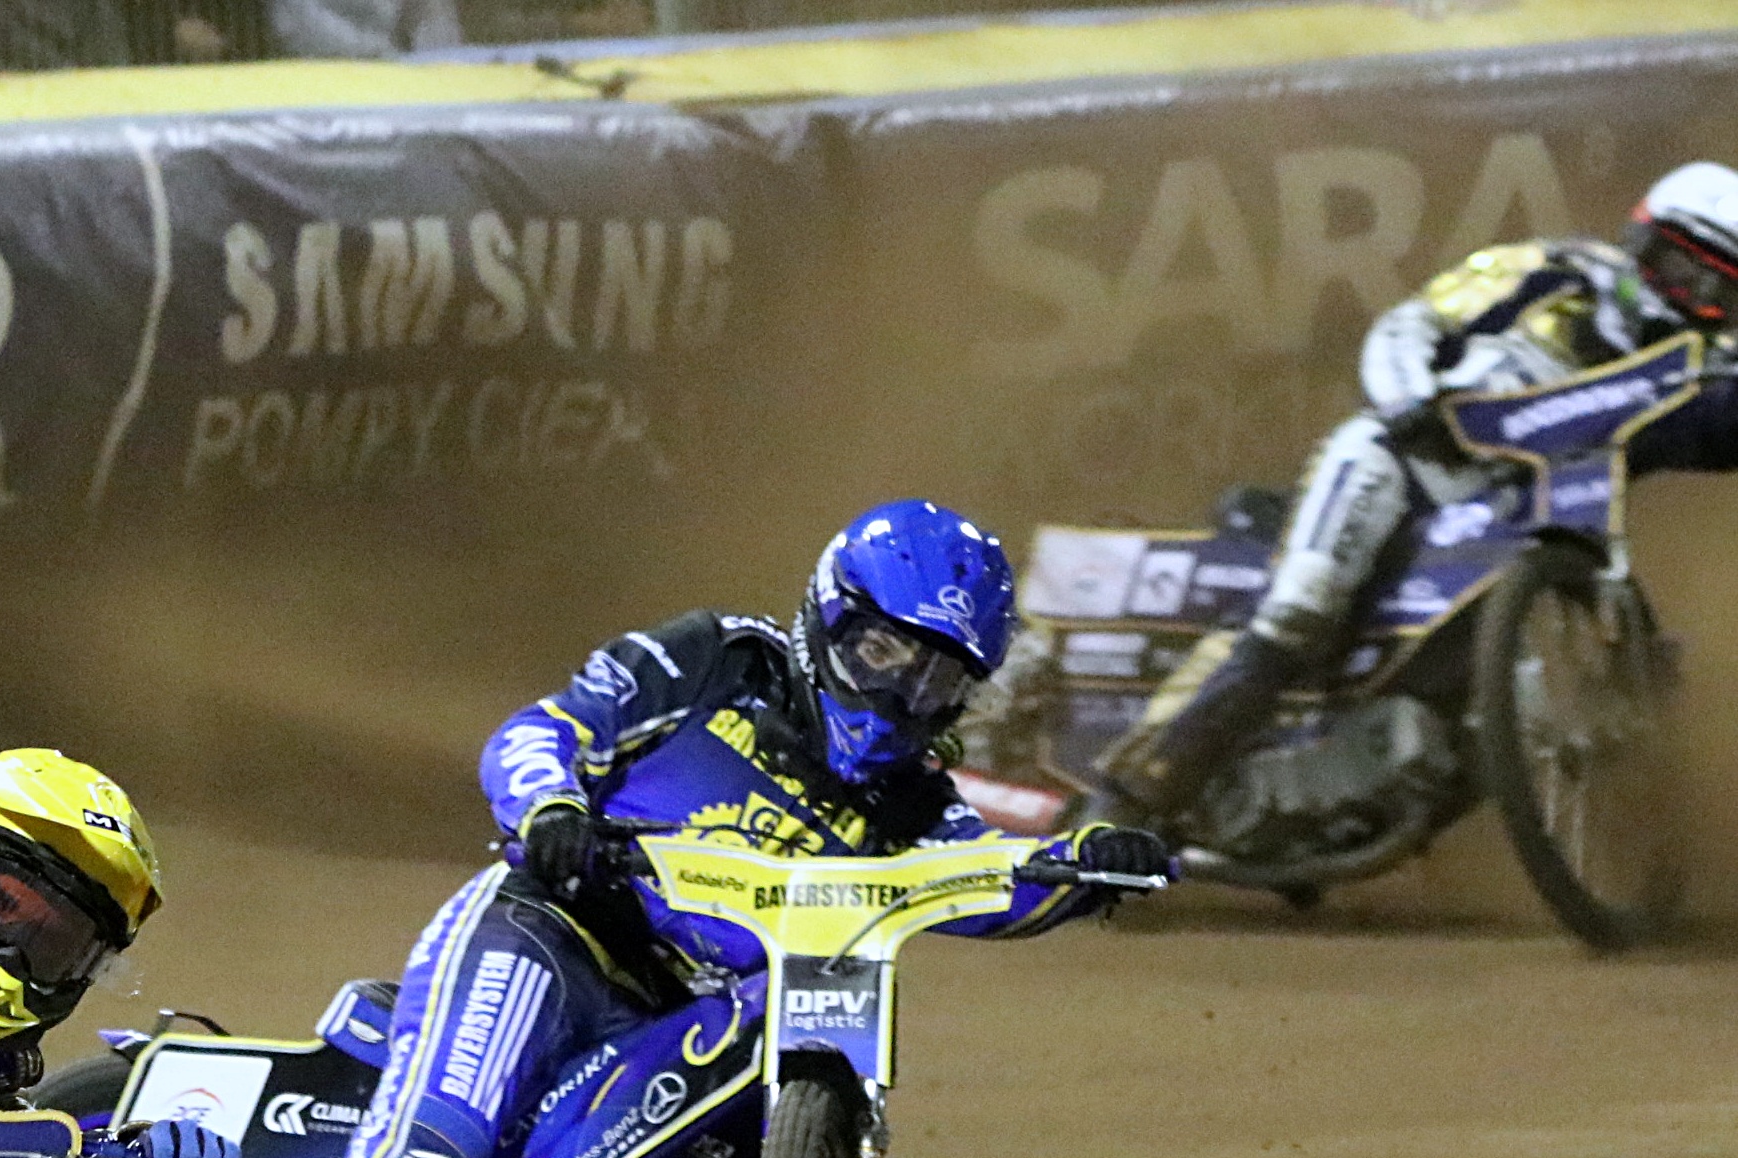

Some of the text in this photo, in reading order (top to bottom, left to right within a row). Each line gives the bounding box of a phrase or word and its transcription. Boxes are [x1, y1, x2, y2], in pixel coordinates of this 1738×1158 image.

[221, 209, 736, 364] SAMSUNG
[754, 883, 910, 911] BAYERSYSTEM
[786, 990, 867, 1014] DPV
[440, 950, 517, 1100] BAYERSYSTEM
[785, 1012, 867, 1032] logistic
